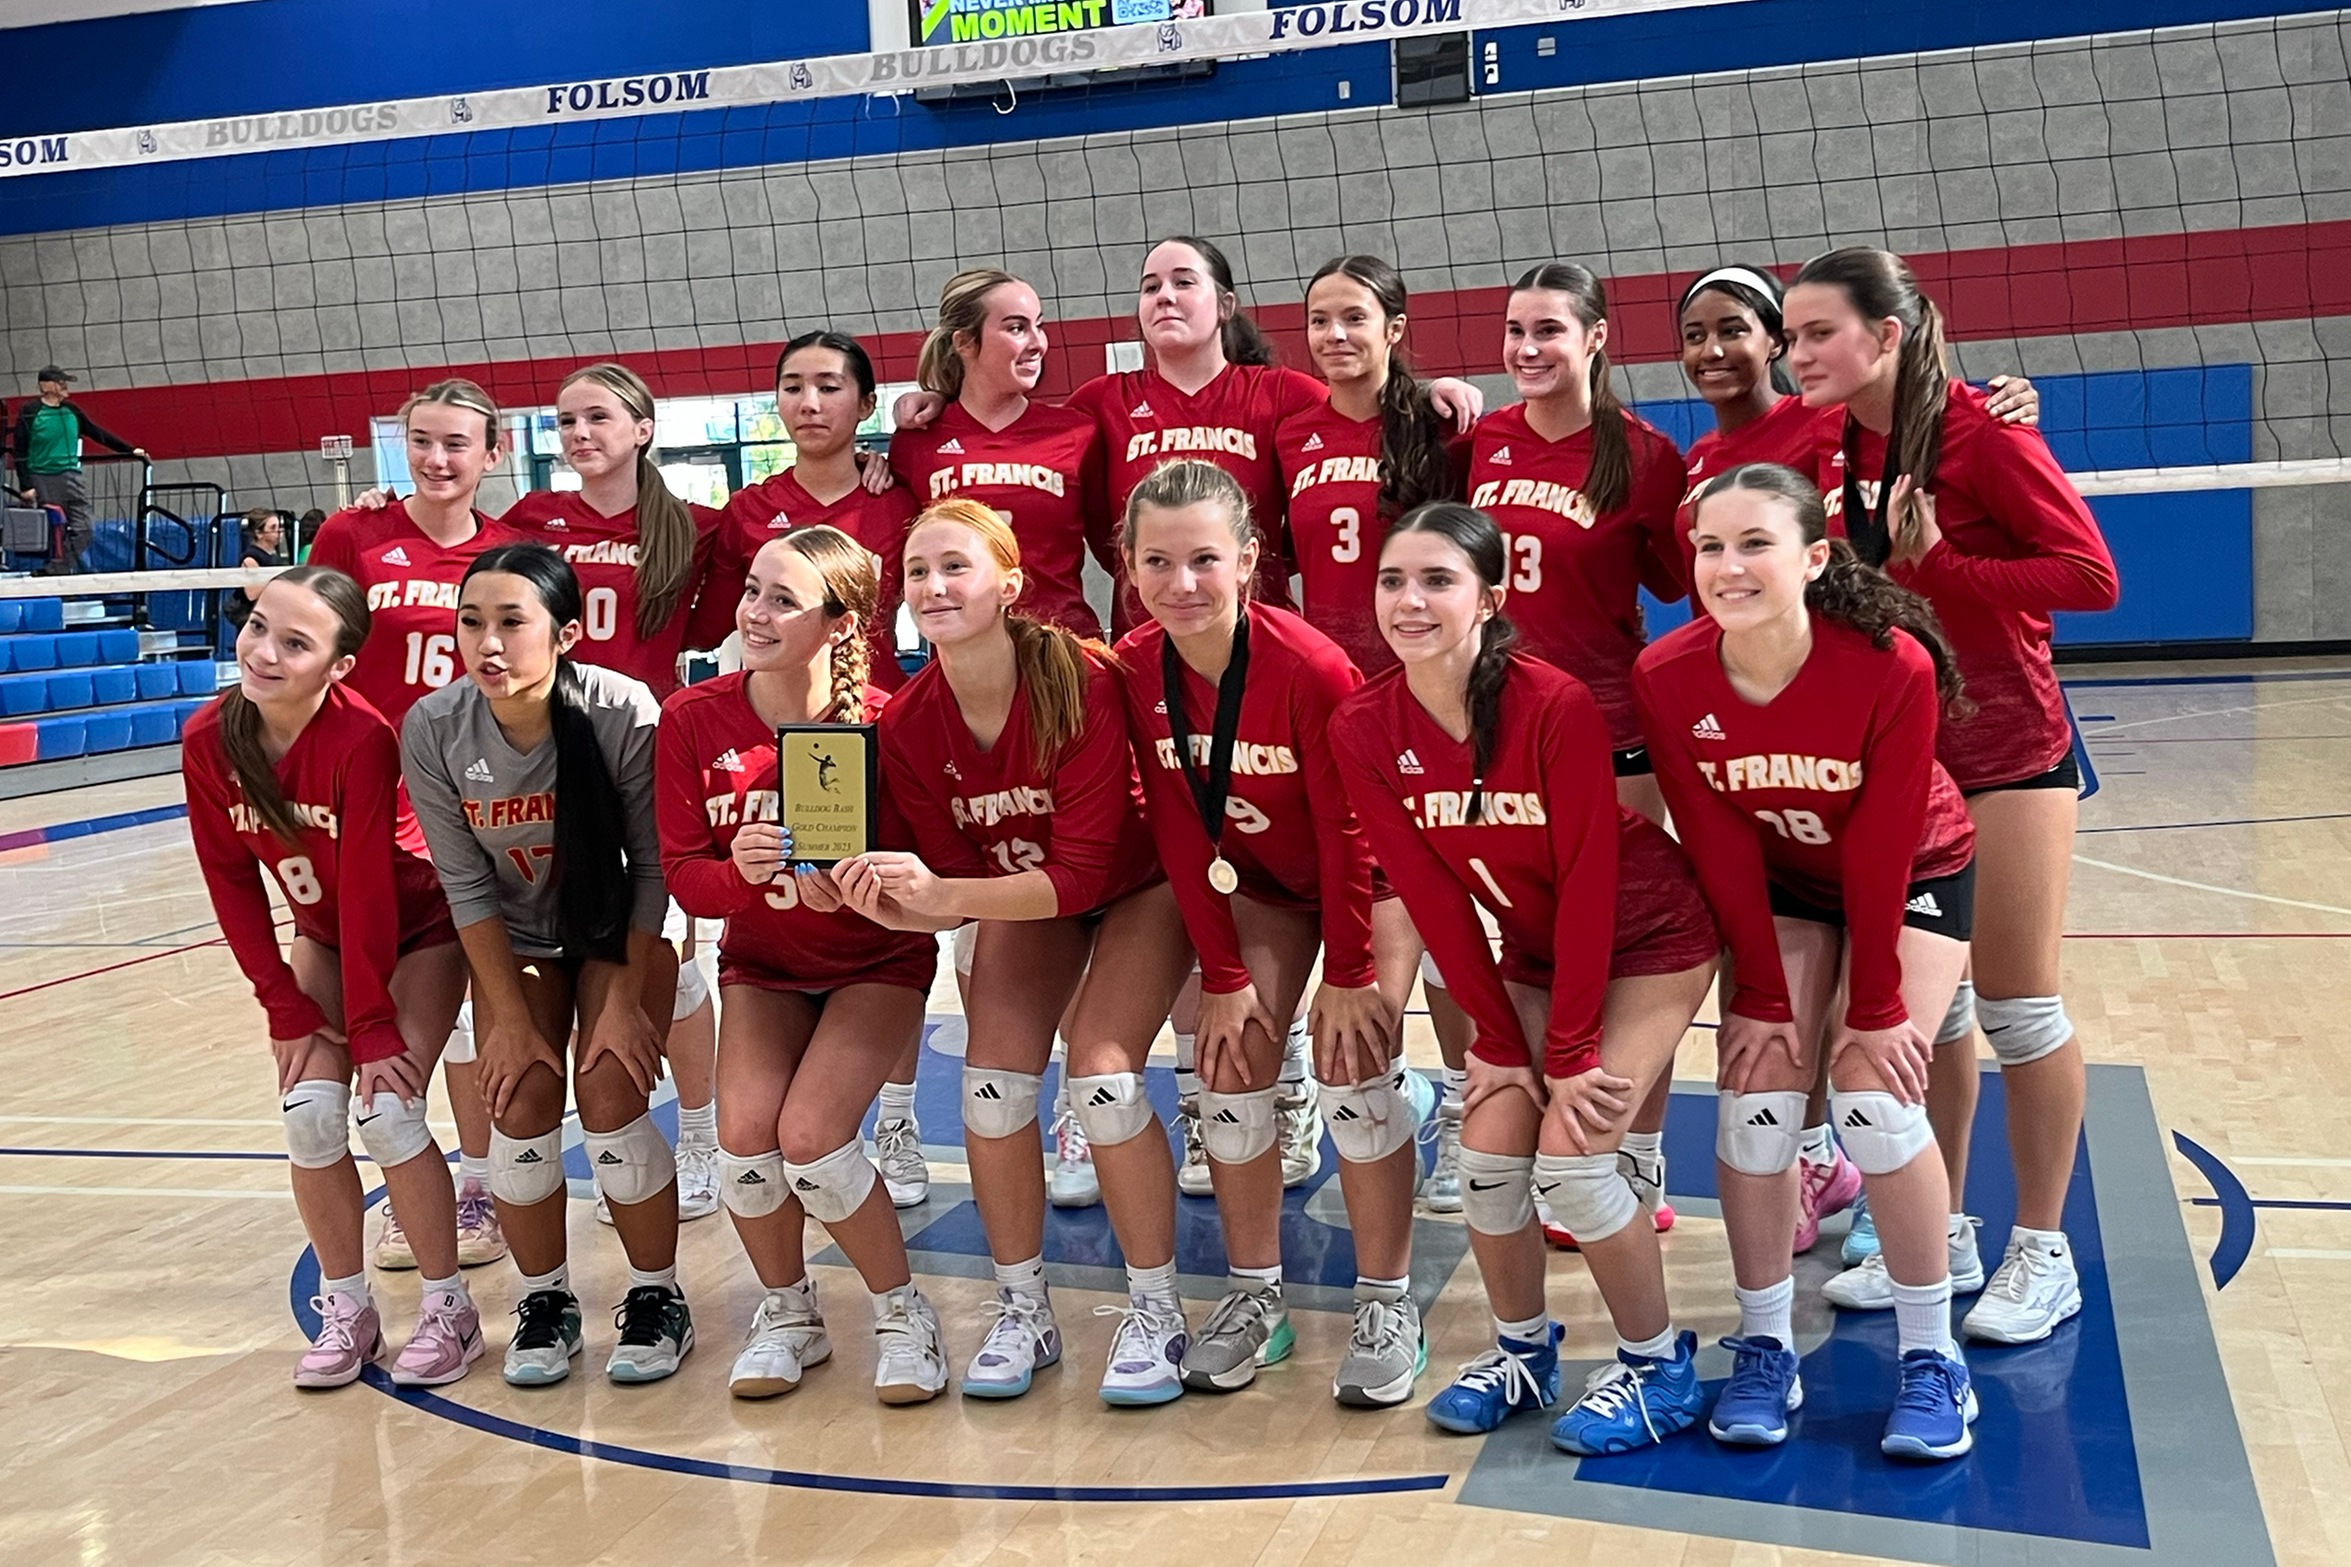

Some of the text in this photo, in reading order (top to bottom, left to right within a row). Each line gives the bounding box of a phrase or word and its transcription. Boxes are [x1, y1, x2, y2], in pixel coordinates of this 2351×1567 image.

[950, 1, 1107, 42] MOMENT
[869, 32, 1097, 81] BULLDOGS
[546, 71, 710, 113] FOLSOM
[205, 104, 398, 147] BULLDOGS
[1126, 426, 1258, 463] ST. FRANCIS
[929, 463, 1065, 500] ST. FRANCIS
[1330, 507, 1361, 563] 3
[367, 581, 402, 612] ST.
[404, 631, 455, 688] 16
[1725, 754, 1864, 793] FRANCIS
[705, 791, 738, 828] ST.
[792, 822, 815, 832] GOLD
[1225, 795, 1271, 834] 9
[277, 856, 322, 905] 8
[1468, 858, 1513, 908] 1
